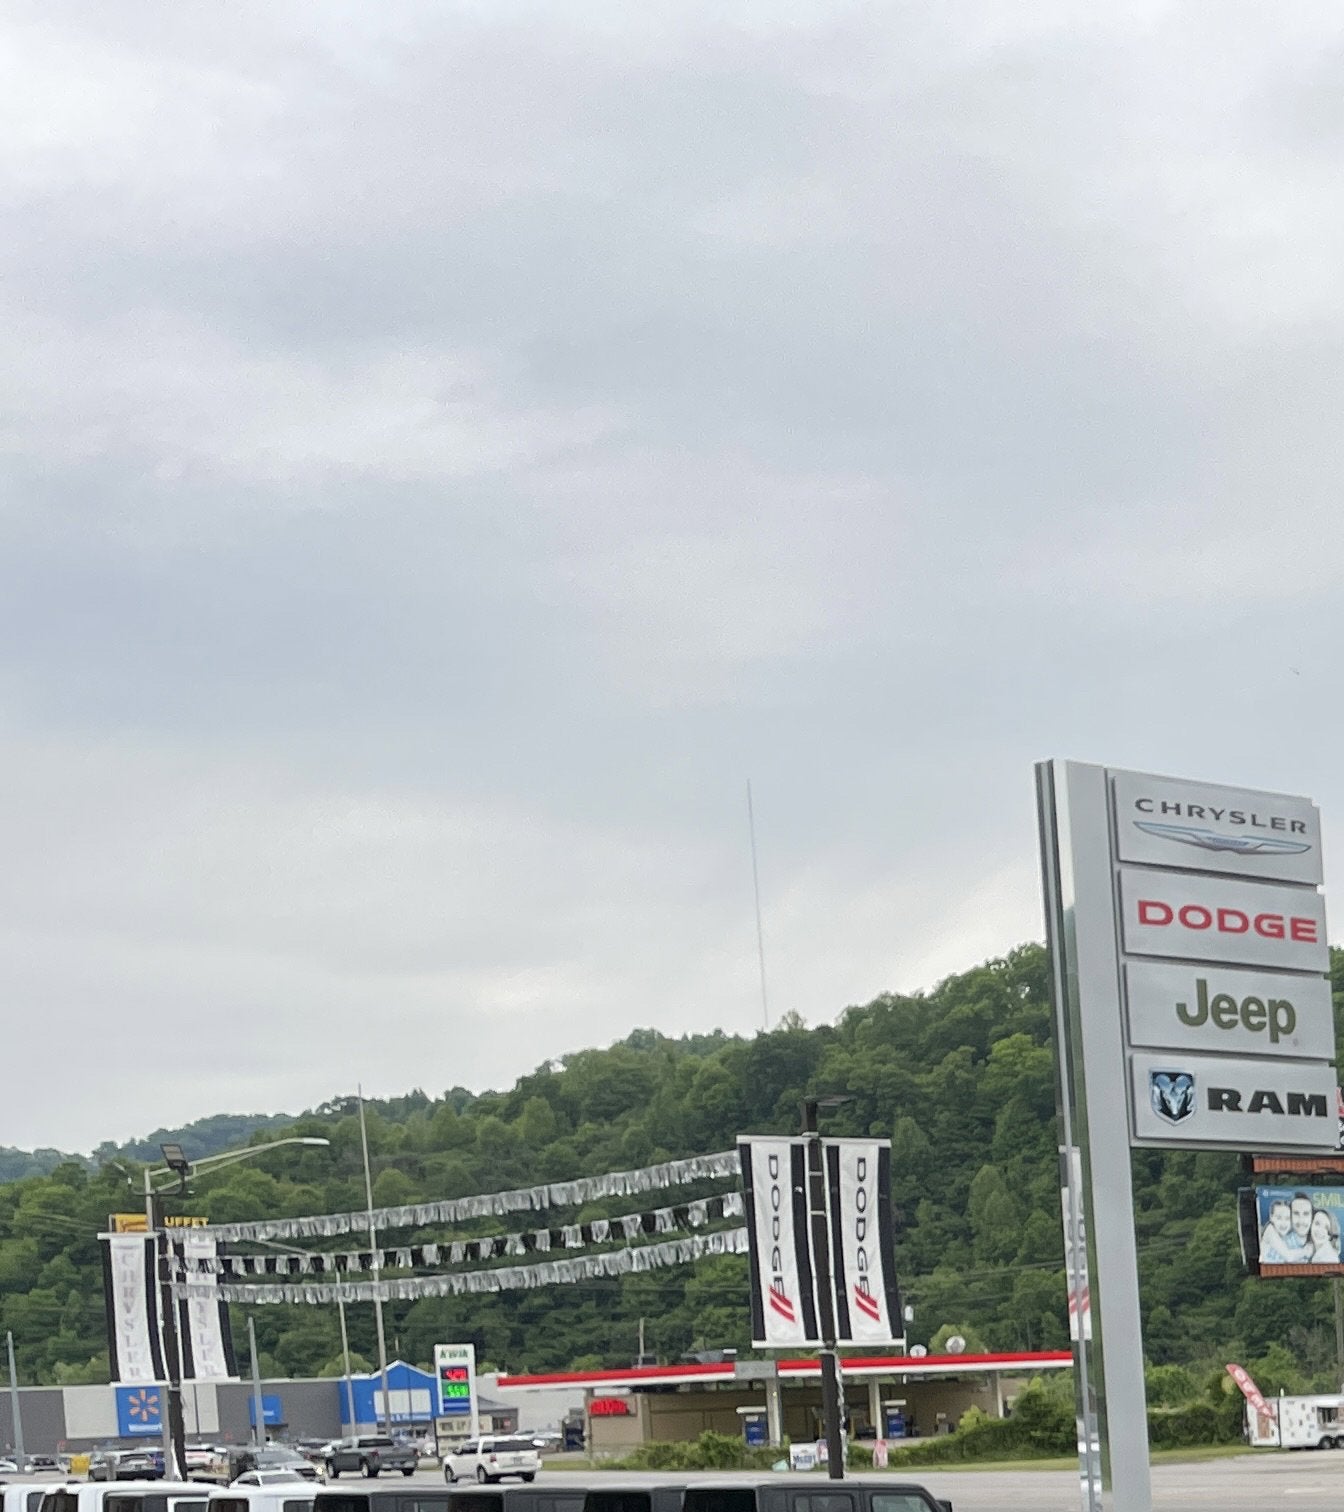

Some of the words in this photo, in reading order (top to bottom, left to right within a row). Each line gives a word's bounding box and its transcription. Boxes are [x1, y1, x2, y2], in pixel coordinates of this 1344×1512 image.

[1135, 798, 1307, 834] CHRYSLER
[1137, 900, 1318, 943] DODGE
[1175, 978, 1296, 1044] Jeep
[1207, 1087, 1328, 1118] RAM
[768, 1154, 786, 1299] DODGE
[855, 1156, 870, 1298] DODGE
